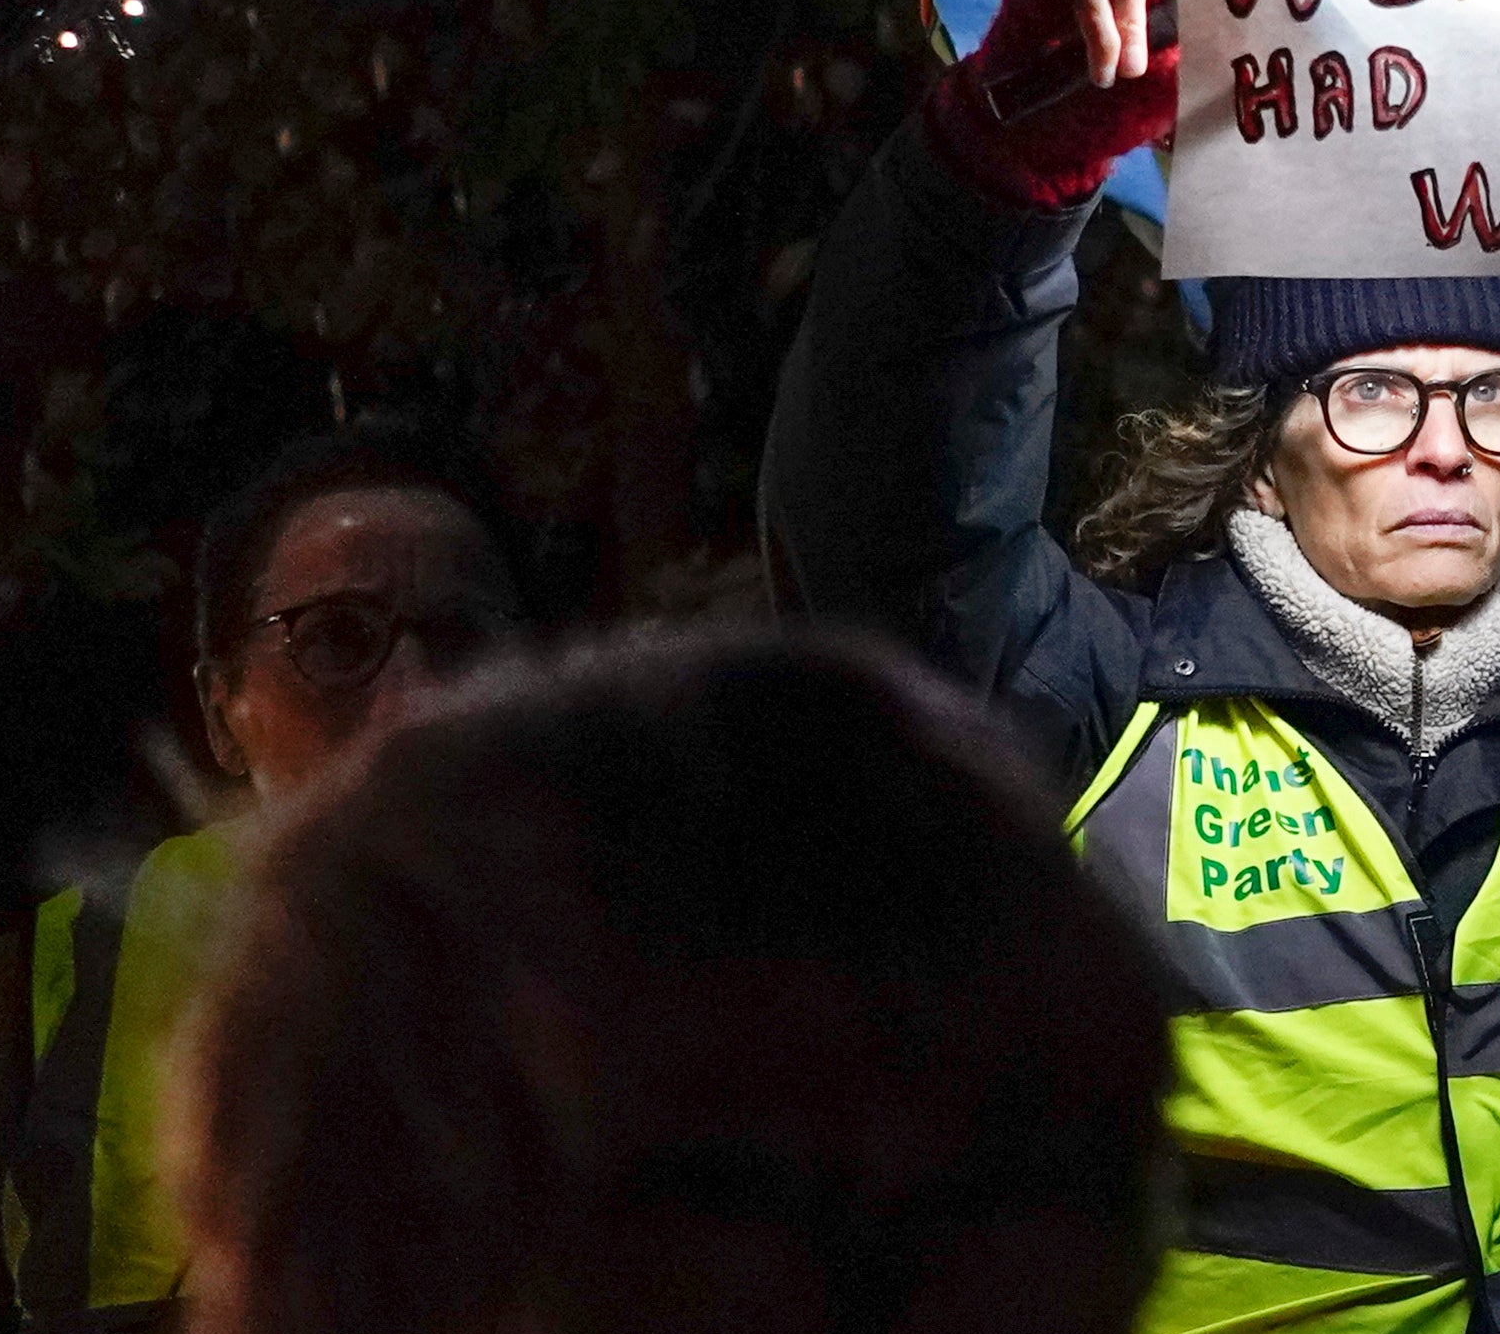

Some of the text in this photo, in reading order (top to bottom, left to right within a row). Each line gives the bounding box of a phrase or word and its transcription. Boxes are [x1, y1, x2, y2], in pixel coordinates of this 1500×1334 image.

[1230, 45, 1427, 144] HAD
[1194, 803, 1337, 848] Green
[1201, 847, 1345, 902] Party
